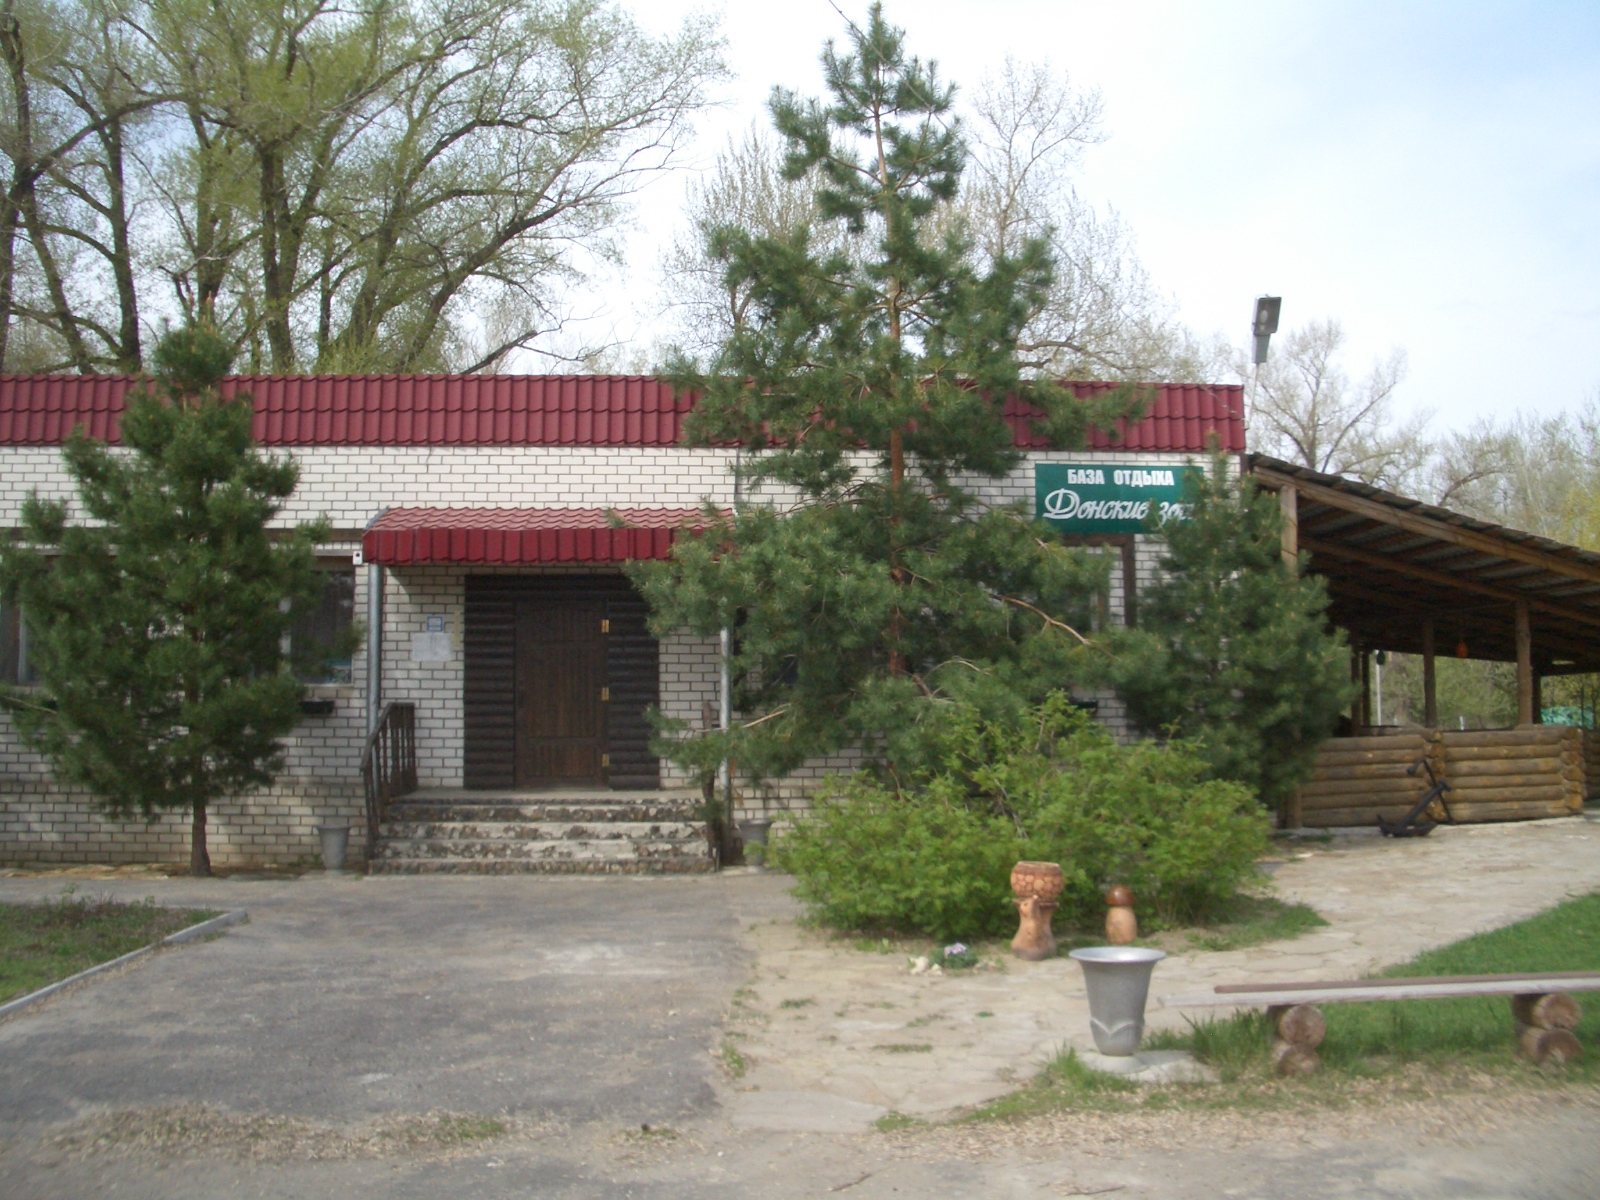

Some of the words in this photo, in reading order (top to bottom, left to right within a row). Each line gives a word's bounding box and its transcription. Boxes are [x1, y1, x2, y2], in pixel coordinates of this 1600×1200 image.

[1067, 469, 1105, 485] БАЗА
[1113, 470, 1175, 488] ОТДЫХА
[1043, 488, 1150, 519] Донские
